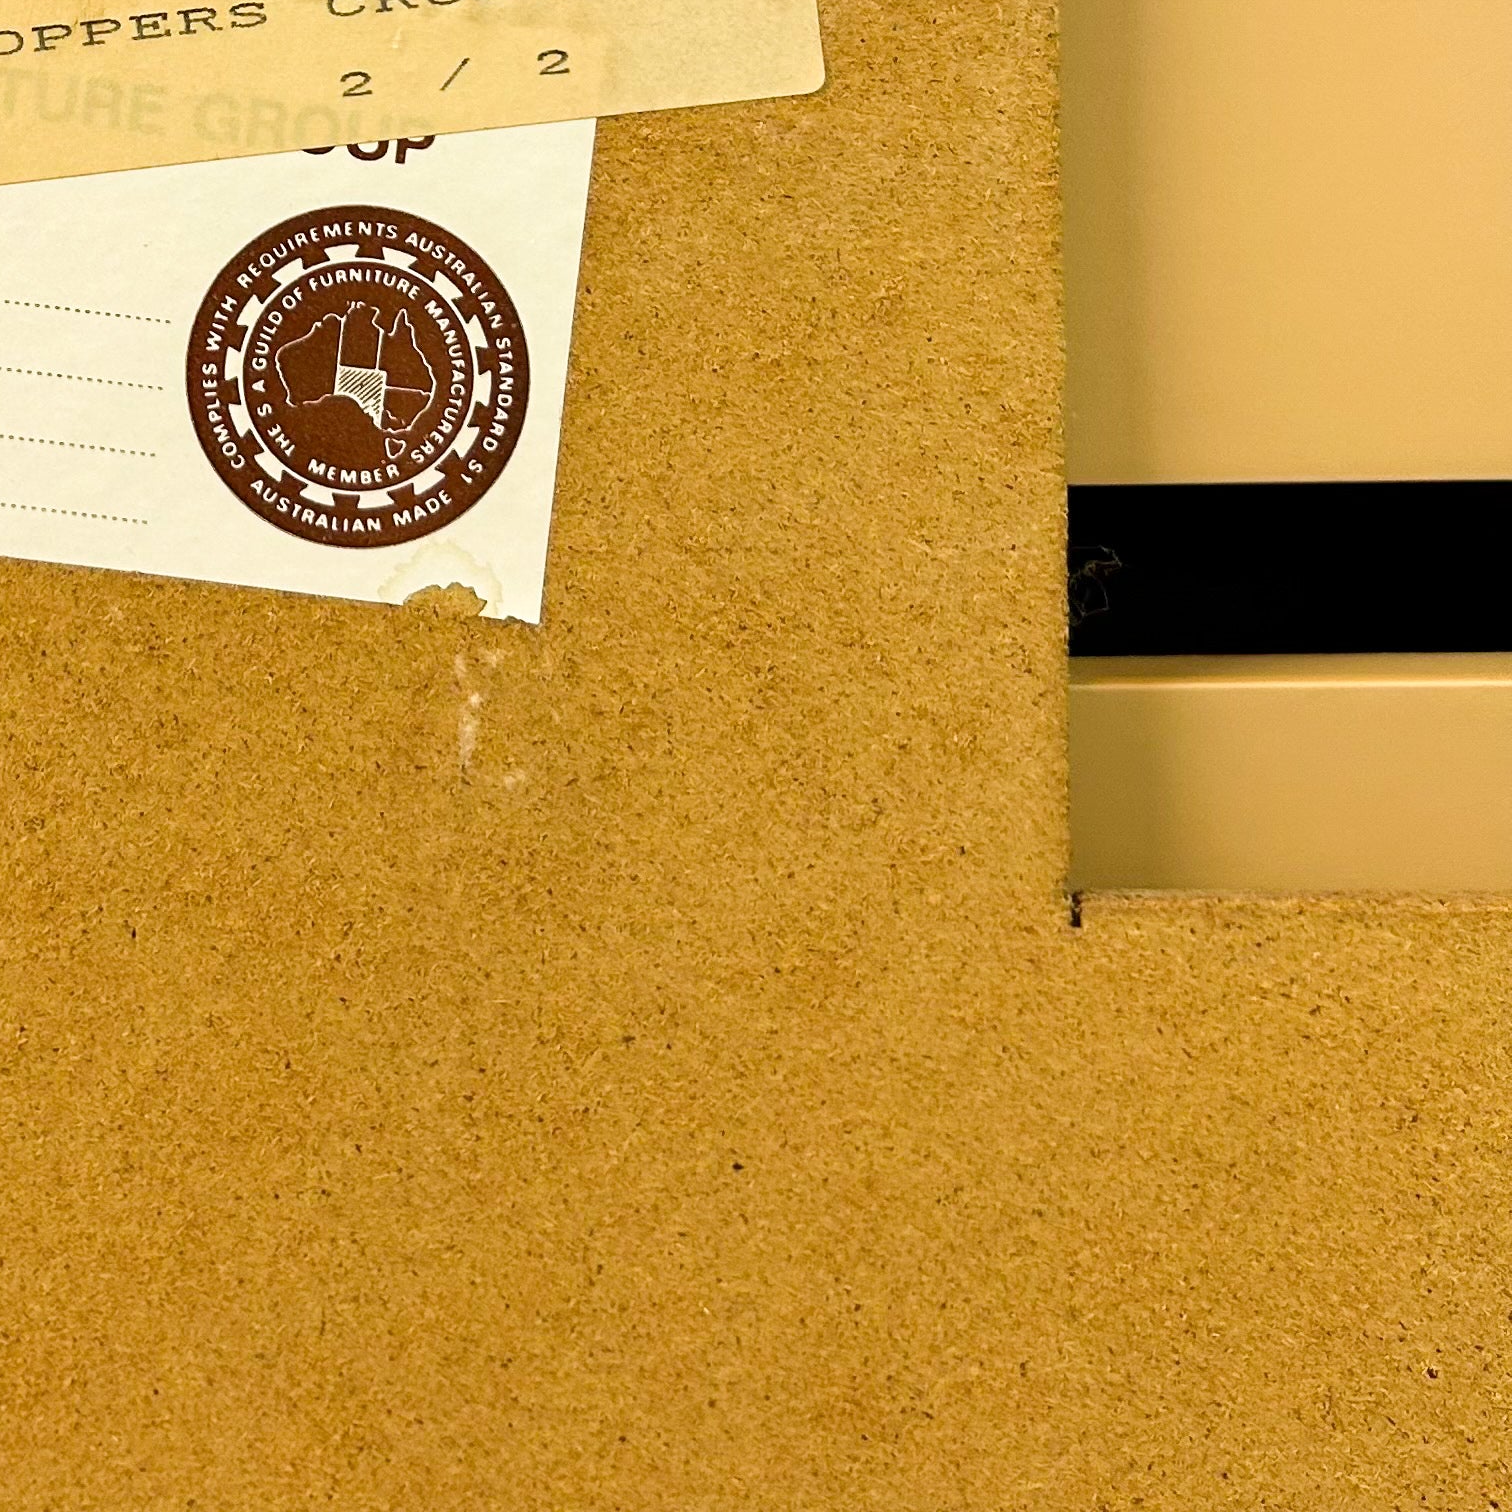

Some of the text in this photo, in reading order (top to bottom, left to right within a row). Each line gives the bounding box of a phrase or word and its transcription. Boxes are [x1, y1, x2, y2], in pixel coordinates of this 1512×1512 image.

[236, 221, 399, 289] REQUIREMENTS
[405, 231, 504, 330] AUSTRALIAN
[281, 286, 304, 310] OF
[308, 268, 420, 301] FURNITURE
[205, 295, 238, 352] WITH
[251, 311, 283, 371] GUILD
[410, 299, 466, 464] MANUFACTURERS
[482, 337, 514, 452] STANDARD
[201, 363, 245, 469] COMPLIES
[267, 423, 296, 457] THE
[307, 458, 400, 485] MEMBER
[250, 479, 453, 532] AUSTRALIAN MADE
